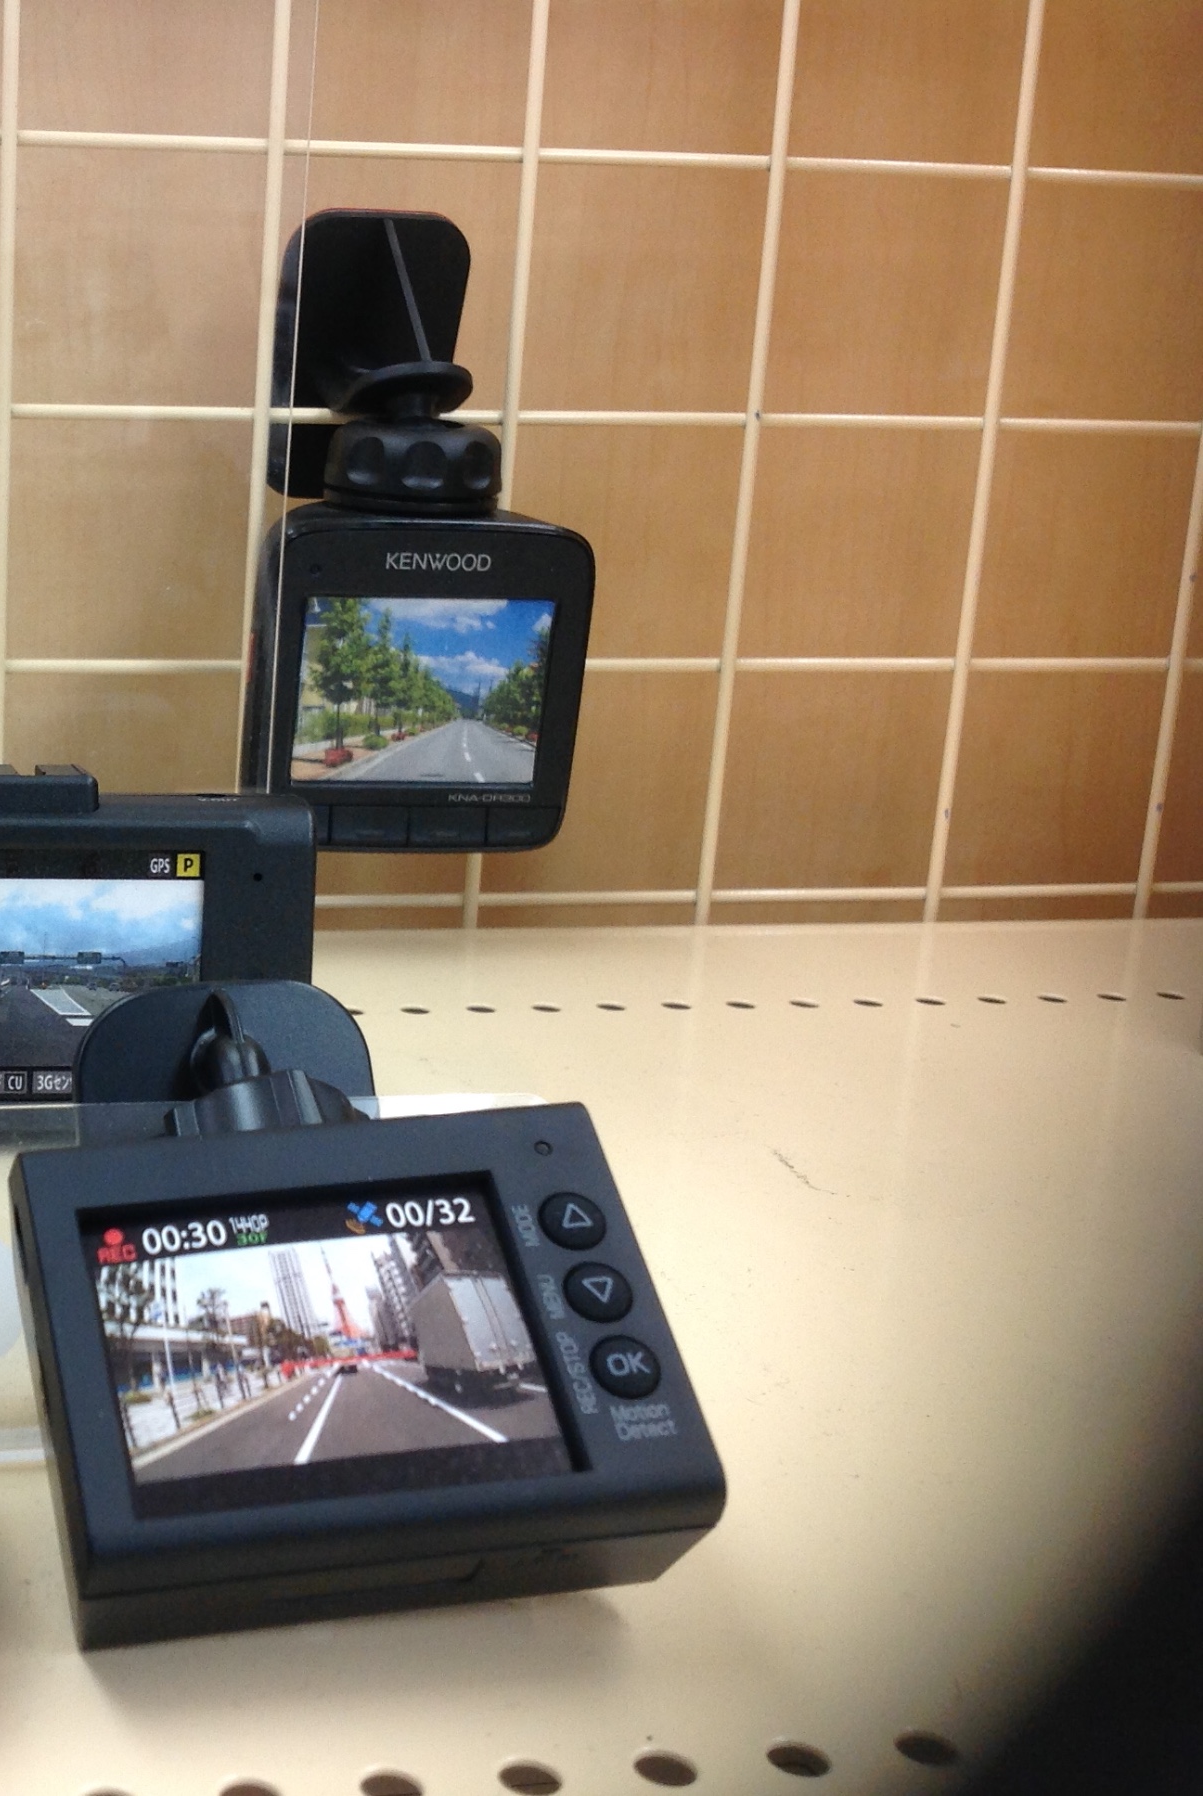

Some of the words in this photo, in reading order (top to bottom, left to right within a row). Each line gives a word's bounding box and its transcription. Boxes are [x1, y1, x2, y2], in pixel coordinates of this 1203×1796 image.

[385, 552, 492, 572] KENWOOD
[150, 857, 170, 874] GPS
[183, 857, 194, 873] P
[36, 1074, 73, 1091] 3Gセン
[385, 1197, 476, 1229] 00/32
[141, 1219, 228, 1256] 00:30
[511, 1203, 541, 1248] MODE
[97, 1243, 138, 1266] REC
[537, 1273, 566, 1320] MENU
[606, 1351, 651, 1377] OK
